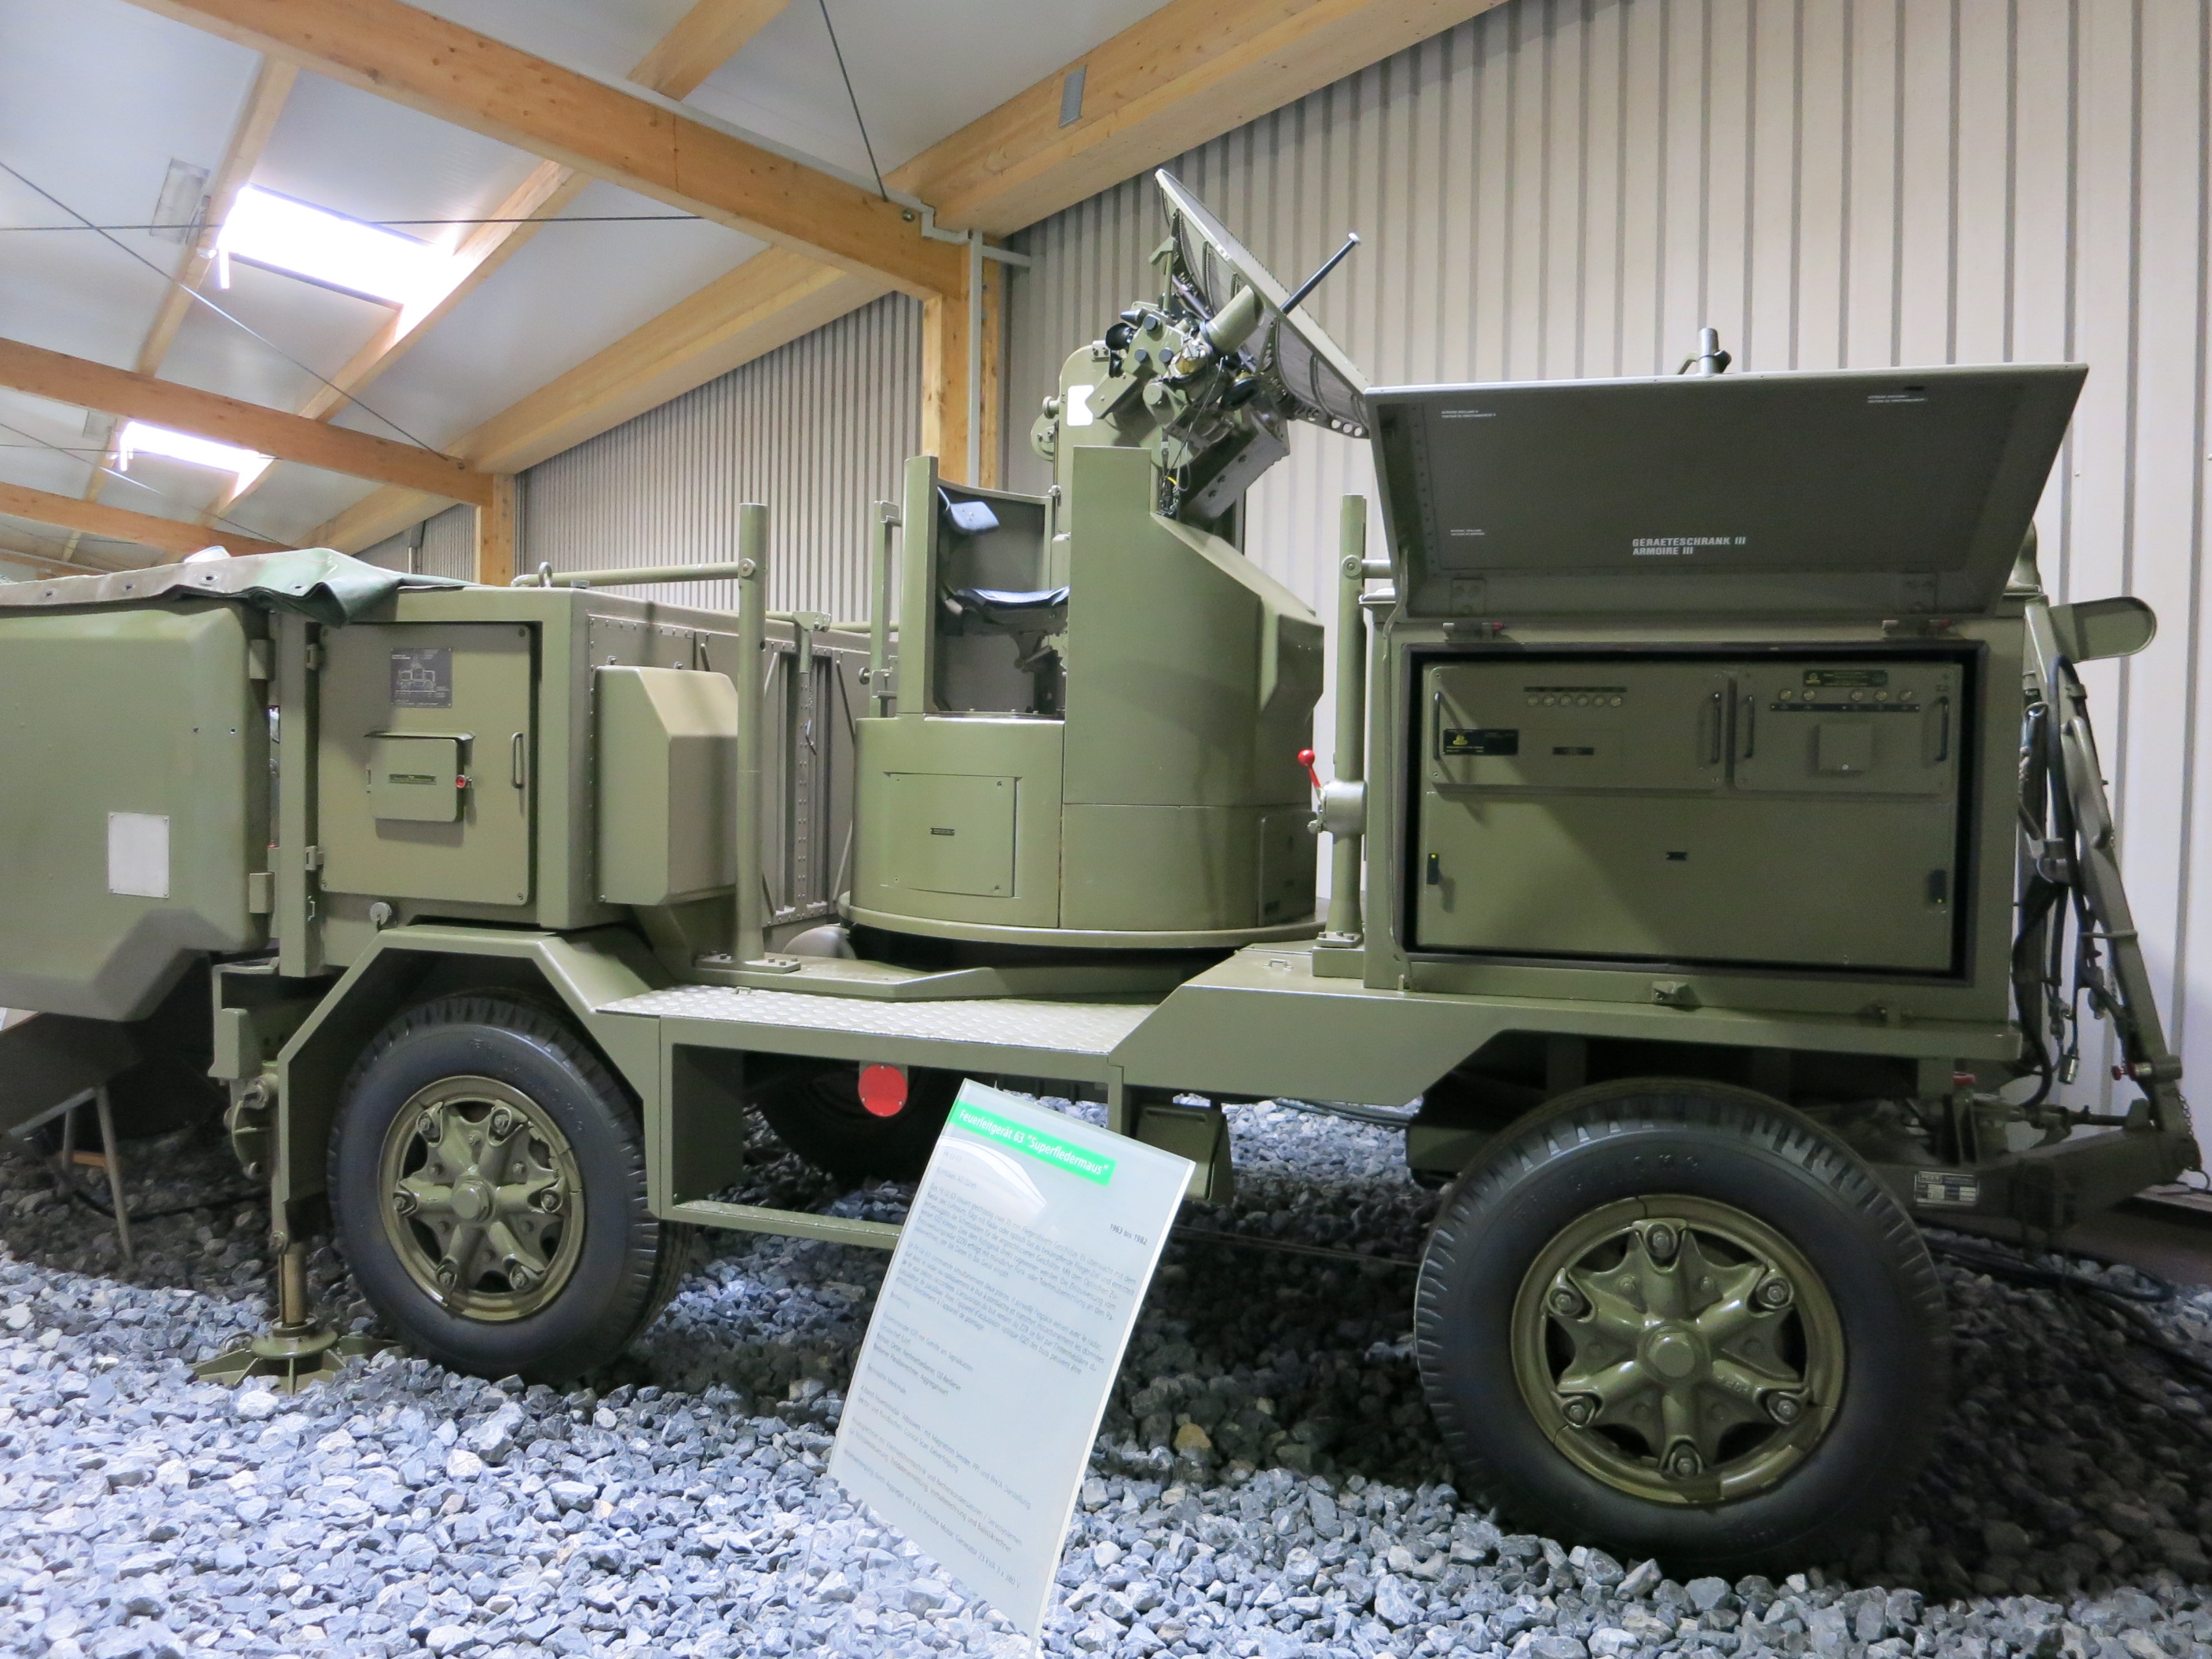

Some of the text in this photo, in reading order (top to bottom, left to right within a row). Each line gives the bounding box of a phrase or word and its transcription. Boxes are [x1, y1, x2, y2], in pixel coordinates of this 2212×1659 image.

[1632, 537, 1746, 547] GERAETESCHRANK III
[1632, 547, 1679, 555] ARMOIRE
[959, 1108, 1013, 1139] Feuerleitgerät
[1013, 1131, 1025, 1143] 63
[1110, 1223, 1148, 1246] 1963 bis 1982
